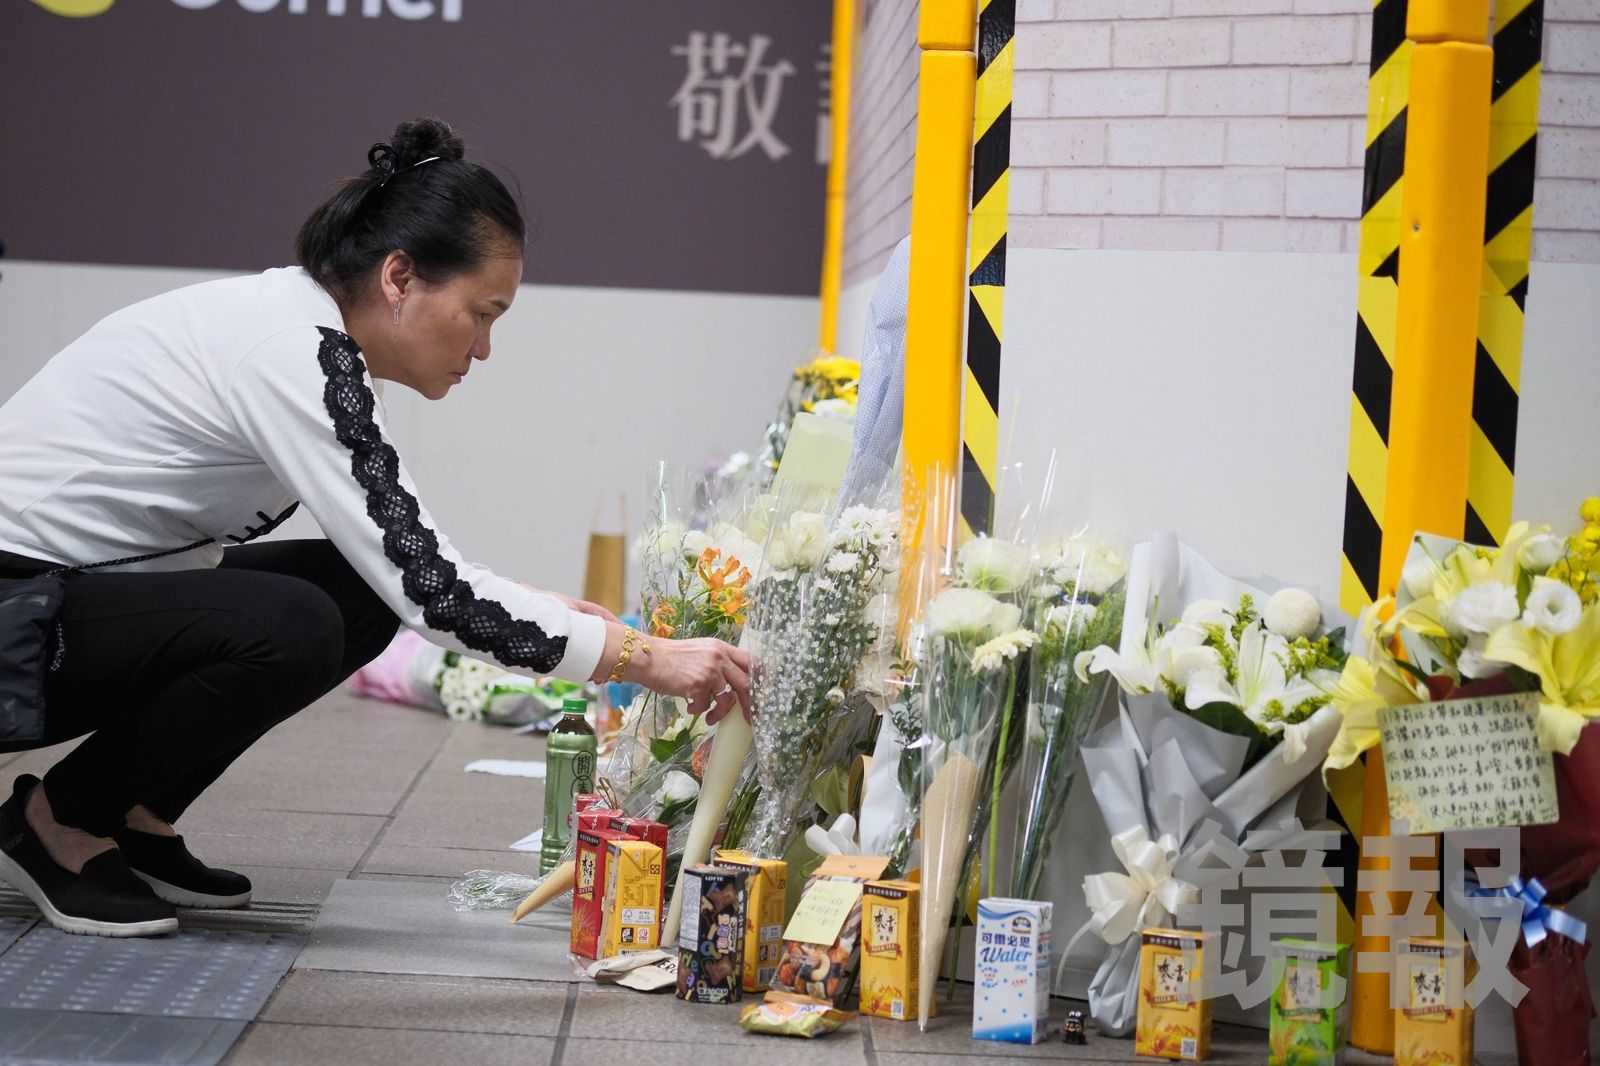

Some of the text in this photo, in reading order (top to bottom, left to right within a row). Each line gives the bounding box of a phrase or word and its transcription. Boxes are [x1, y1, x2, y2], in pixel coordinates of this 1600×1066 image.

[668, 30, 832, 166] 敬
[981, 932, 1031, 948] 可爾必思
[980, 947, 1032, 963] Water
